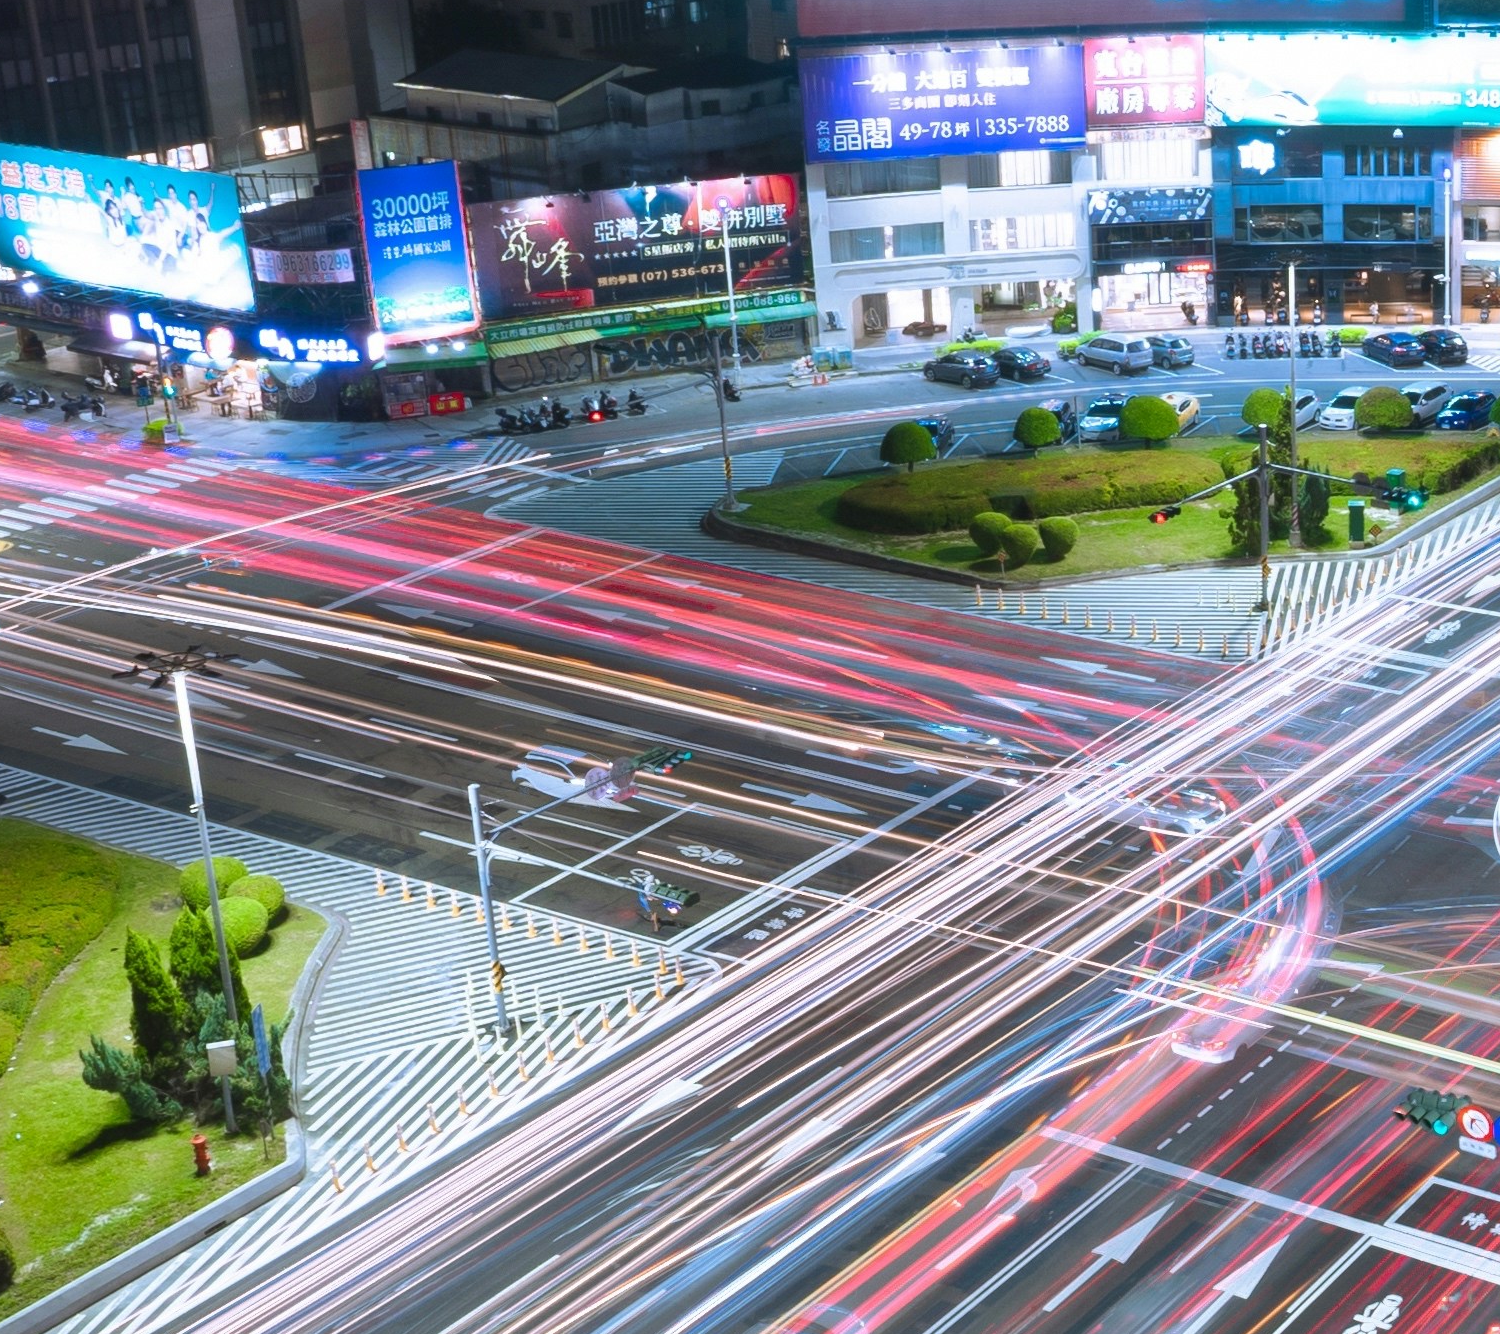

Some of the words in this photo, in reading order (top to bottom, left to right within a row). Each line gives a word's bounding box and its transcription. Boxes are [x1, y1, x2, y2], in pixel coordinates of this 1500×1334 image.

[853, 72, 907, 92] 一分
[985, 114, 1070, 137] 335-7888
[372, 191, 450, 220] 30000坪
[373, 213, 453, 238] 森林公園首排
[641, 269, 668, 284] (07)
[671, 263, 731, 280] 536-673
[722, 292, 798, 311] 000-088-966
